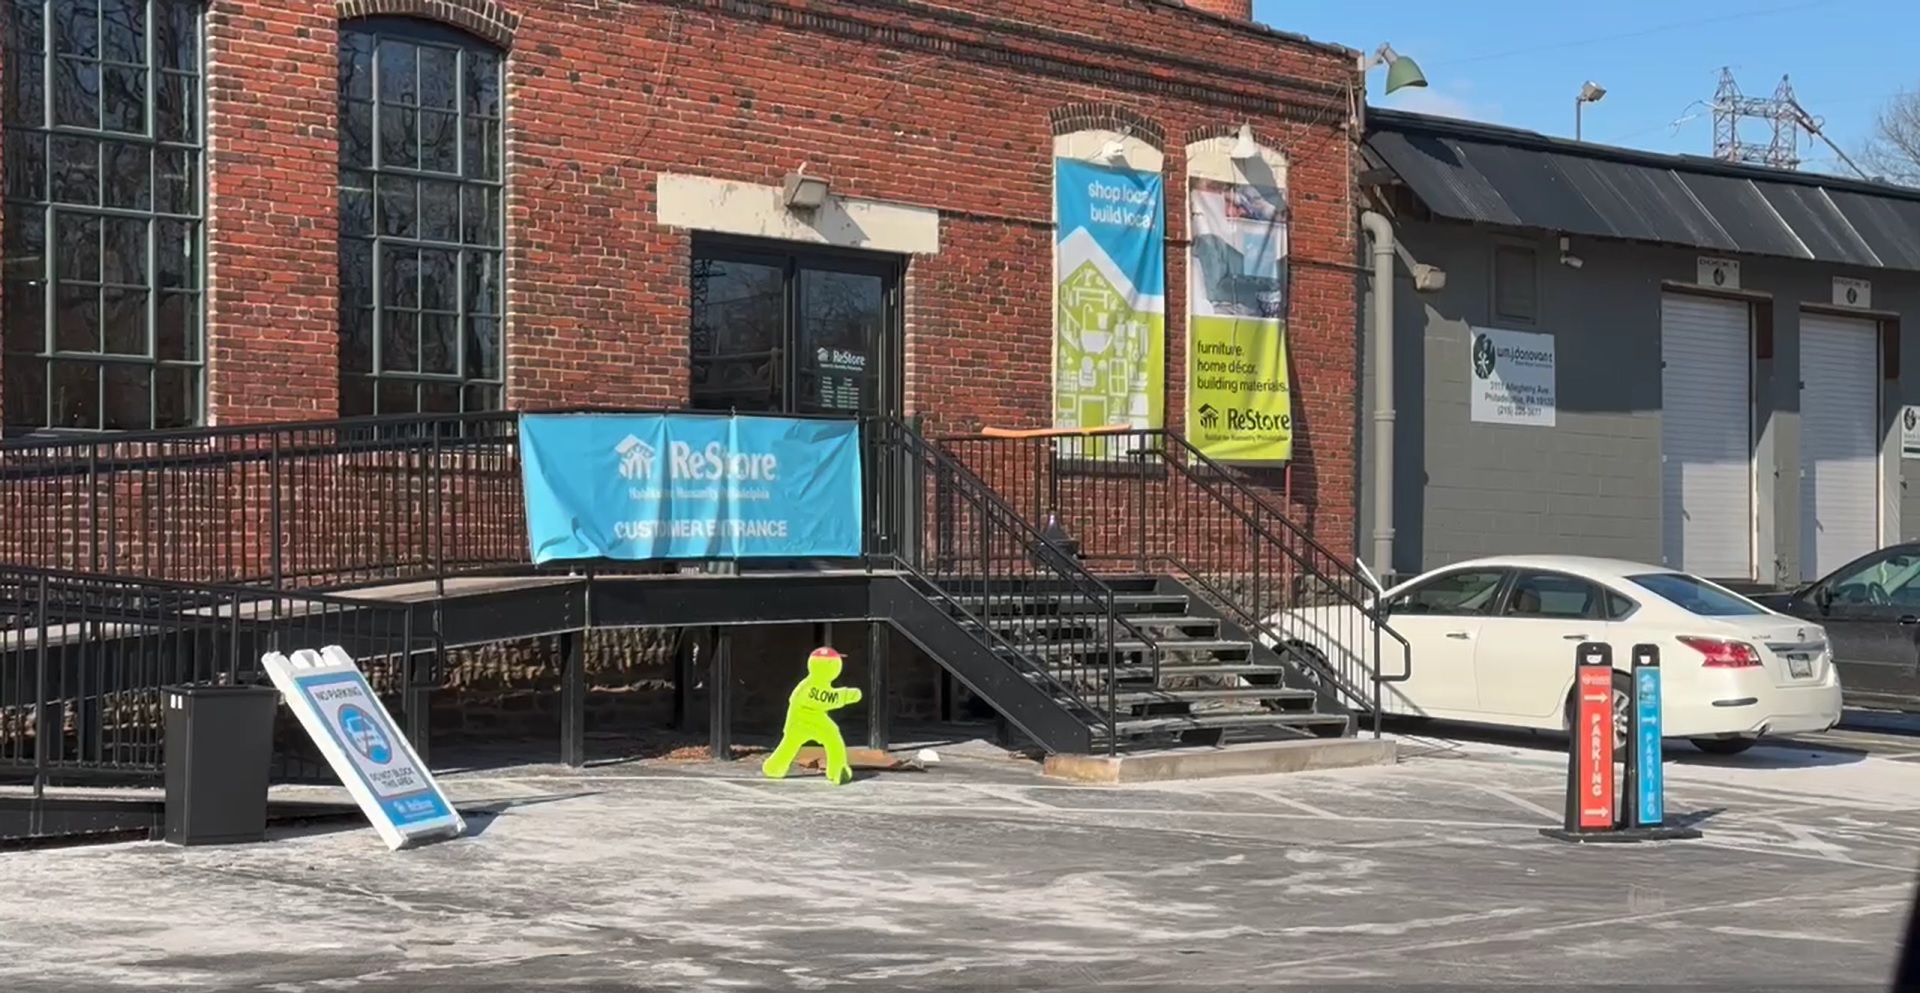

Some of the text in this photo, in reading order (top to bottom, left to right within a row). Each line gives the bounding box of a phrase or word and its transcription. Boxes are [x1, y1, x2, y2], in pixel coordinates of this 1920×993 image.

[1088, 180, 1120, 203] shop
[1090, 203, 1121, 225] build
[1699, 259, 1729, 267] DOCK
[832, 349, 866, 366] ReStore
[1197, 360, 1258, 375] home décor.
[1197, 376, 1289, 393] building materials.
[1228, 407, 1291, 431] ReStore
[669, 440, 778, 482] ReStore
[613, 519, 788, 539] CUSTOMER ENTRANCE
[327, 686, 363, 699] PARKING
[1591, 712, 1602, 797] PARKING
[1644, 733, 1655, 816] PARKING
